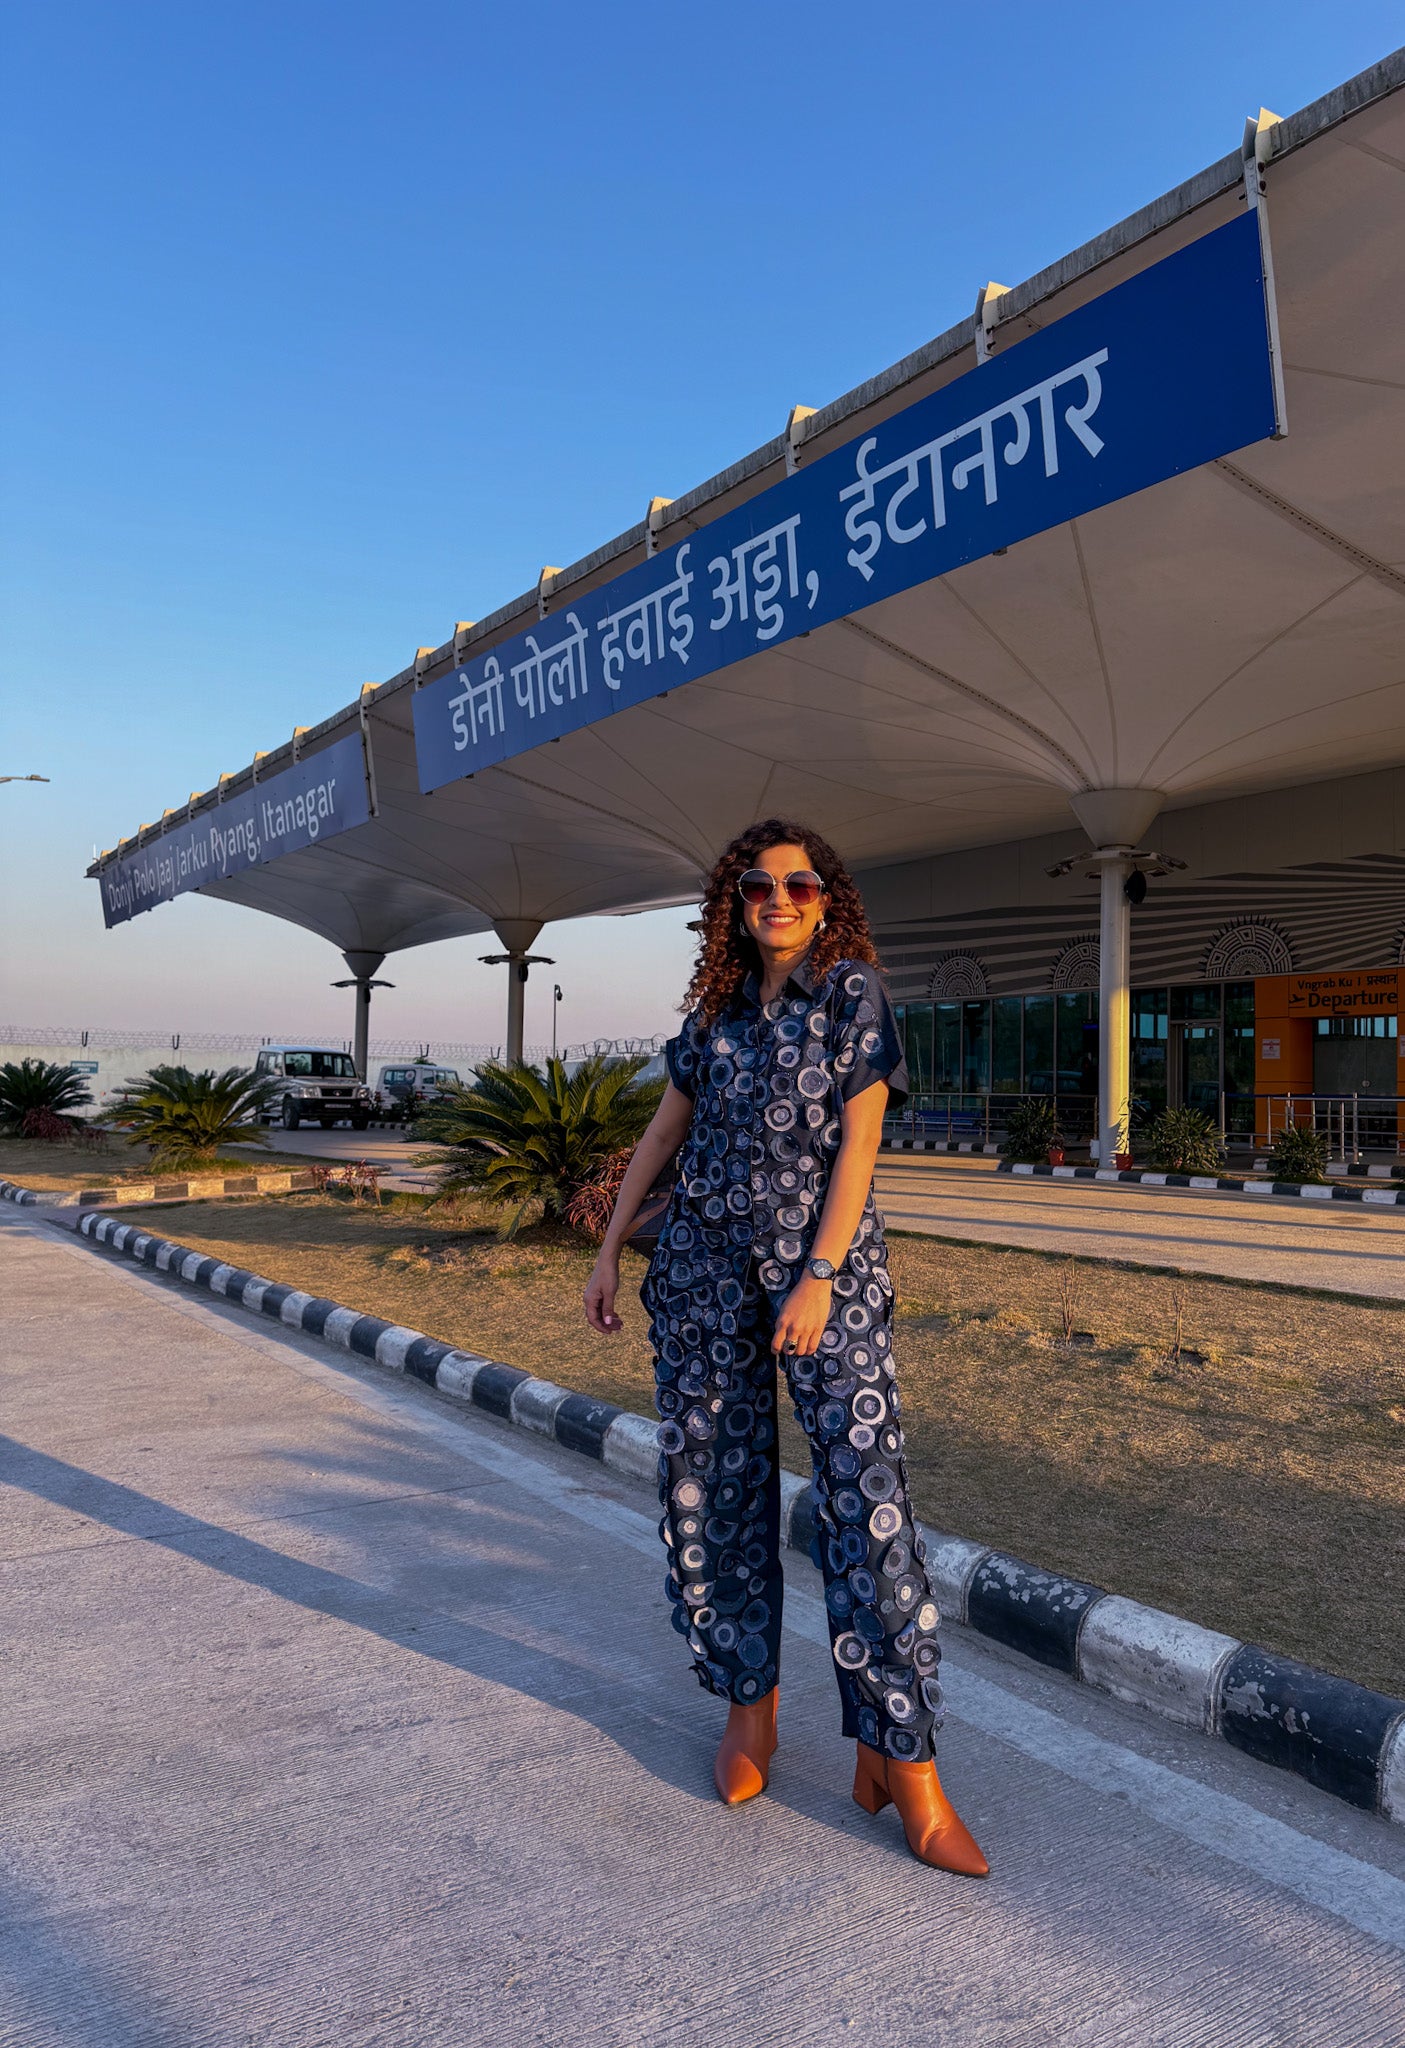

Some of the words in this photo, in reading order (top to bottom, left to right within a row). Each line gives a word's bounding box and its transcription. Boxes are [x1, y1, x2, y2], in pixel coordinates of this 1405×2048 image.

[448, 656, 505, 751] डोनी
[510, 612, 588, 719] पोलो
[598, 543, 694, 691] हवाई
[707, 513, 820, 640] अड्डा,
[839, 347, 1108, 582] ईटानगर
[108, 870, 135, 914] Donyi
[134, 860, 156, 899] Polo
[155, 845, 175, 896] Jaaj
[176, 833, 208, 885] Jarku
[209, 818, 261, 873] Ryang,
[262, 778, 336, 841] Itanagar
[1297, 978, 1335, 992] Vngrab
[1338, 978, 1353, 987] Ku
[1366, 974, 1397, 986] प्रस्थान
[1308, 990, 1397, 1012] Departure
